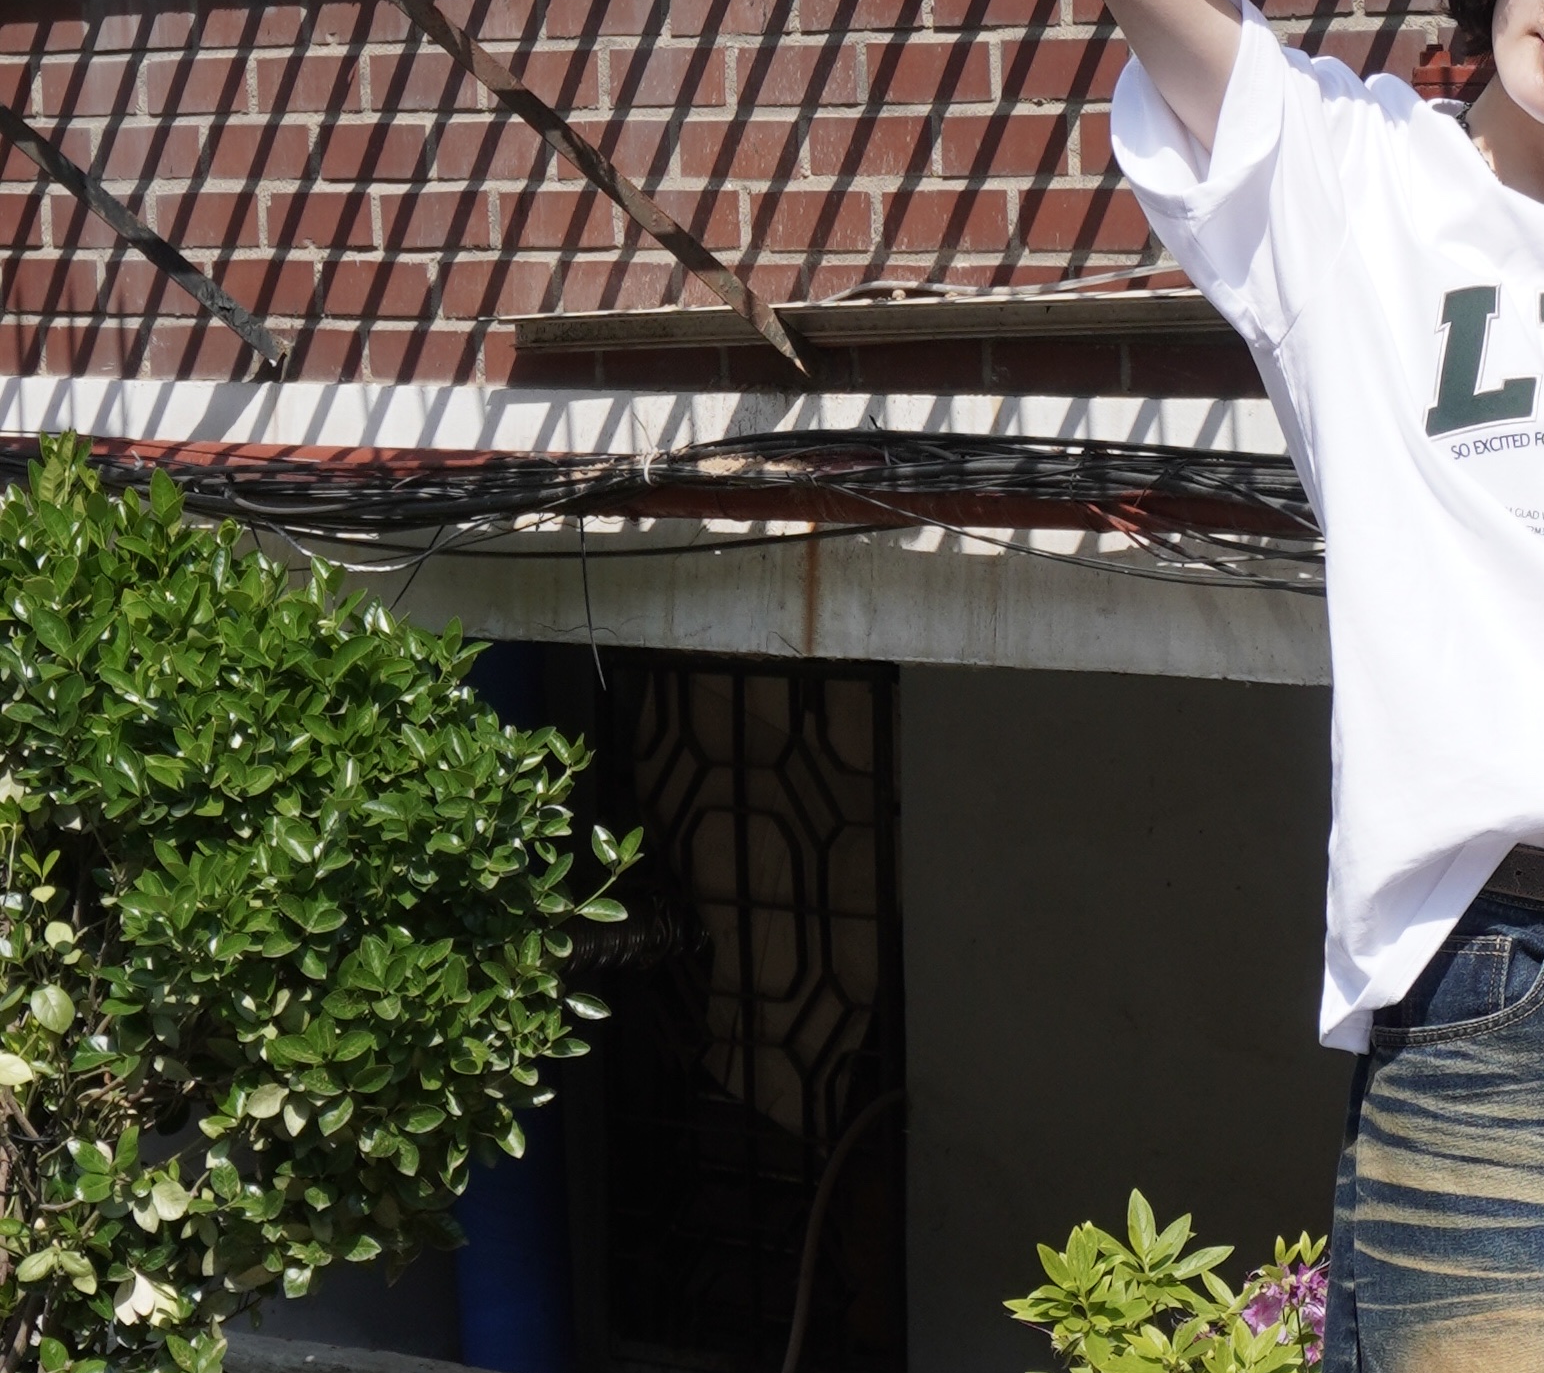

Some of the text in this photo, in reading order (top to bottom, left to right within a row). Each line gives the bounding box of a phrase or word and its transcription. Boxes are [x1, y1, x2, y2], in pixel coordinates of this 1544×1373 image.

[1451, 443, 1470, 460] SO
[1473, 433, 1530, 455] EXCITED
[1514, 508, 1540, 520] GLAD
